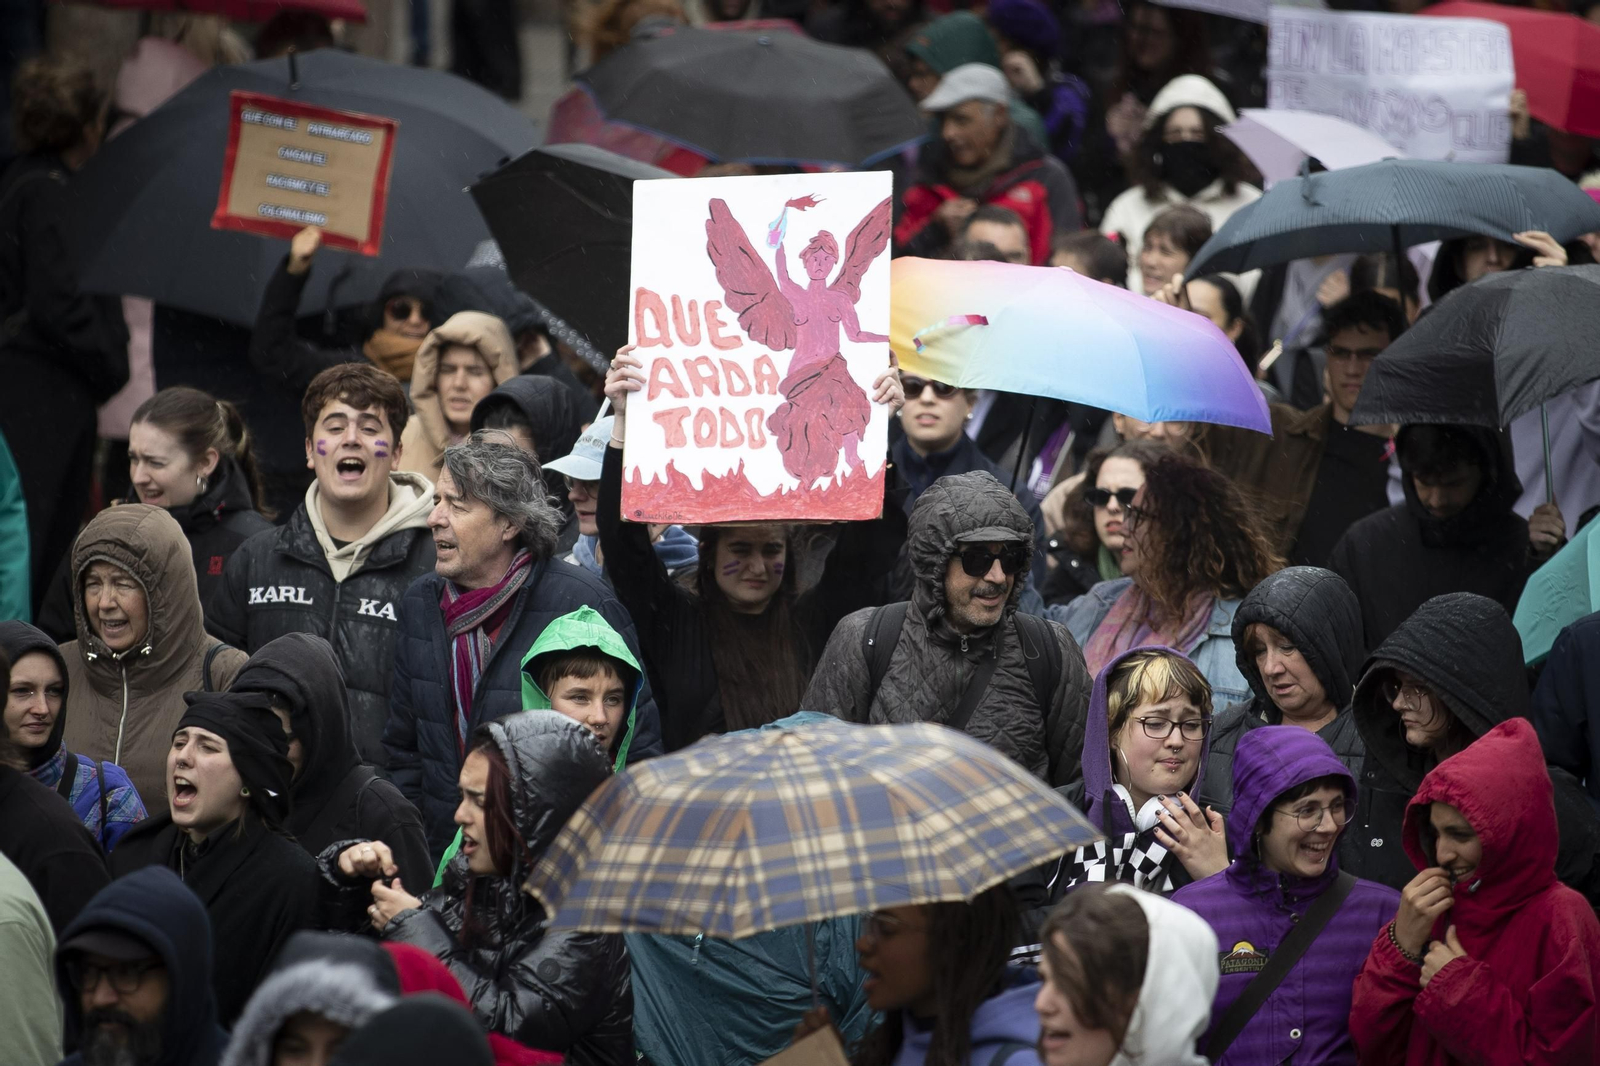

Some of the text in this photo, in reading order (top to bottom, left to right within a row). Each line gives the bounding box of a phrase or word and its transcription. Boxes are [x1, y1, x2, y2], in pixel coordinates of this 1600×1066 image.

[1328, 21, 1369, 75] LA
[241, 110, 373, 145] QUE CON EL PATRIARCADO
[278, 145, 328, 166] CAIGAN EL
[266, 173, 307, 193] RACISMO
[316, 181, 330, 197] EL
[258, 203, 328, 225] COLONIALISMO
[635, 287, 743, 350] QUE
[647, 354, 780, 401] ARDA
[652, 406, 767, 450] TODO
[248, 586, 314, 605] KARL
